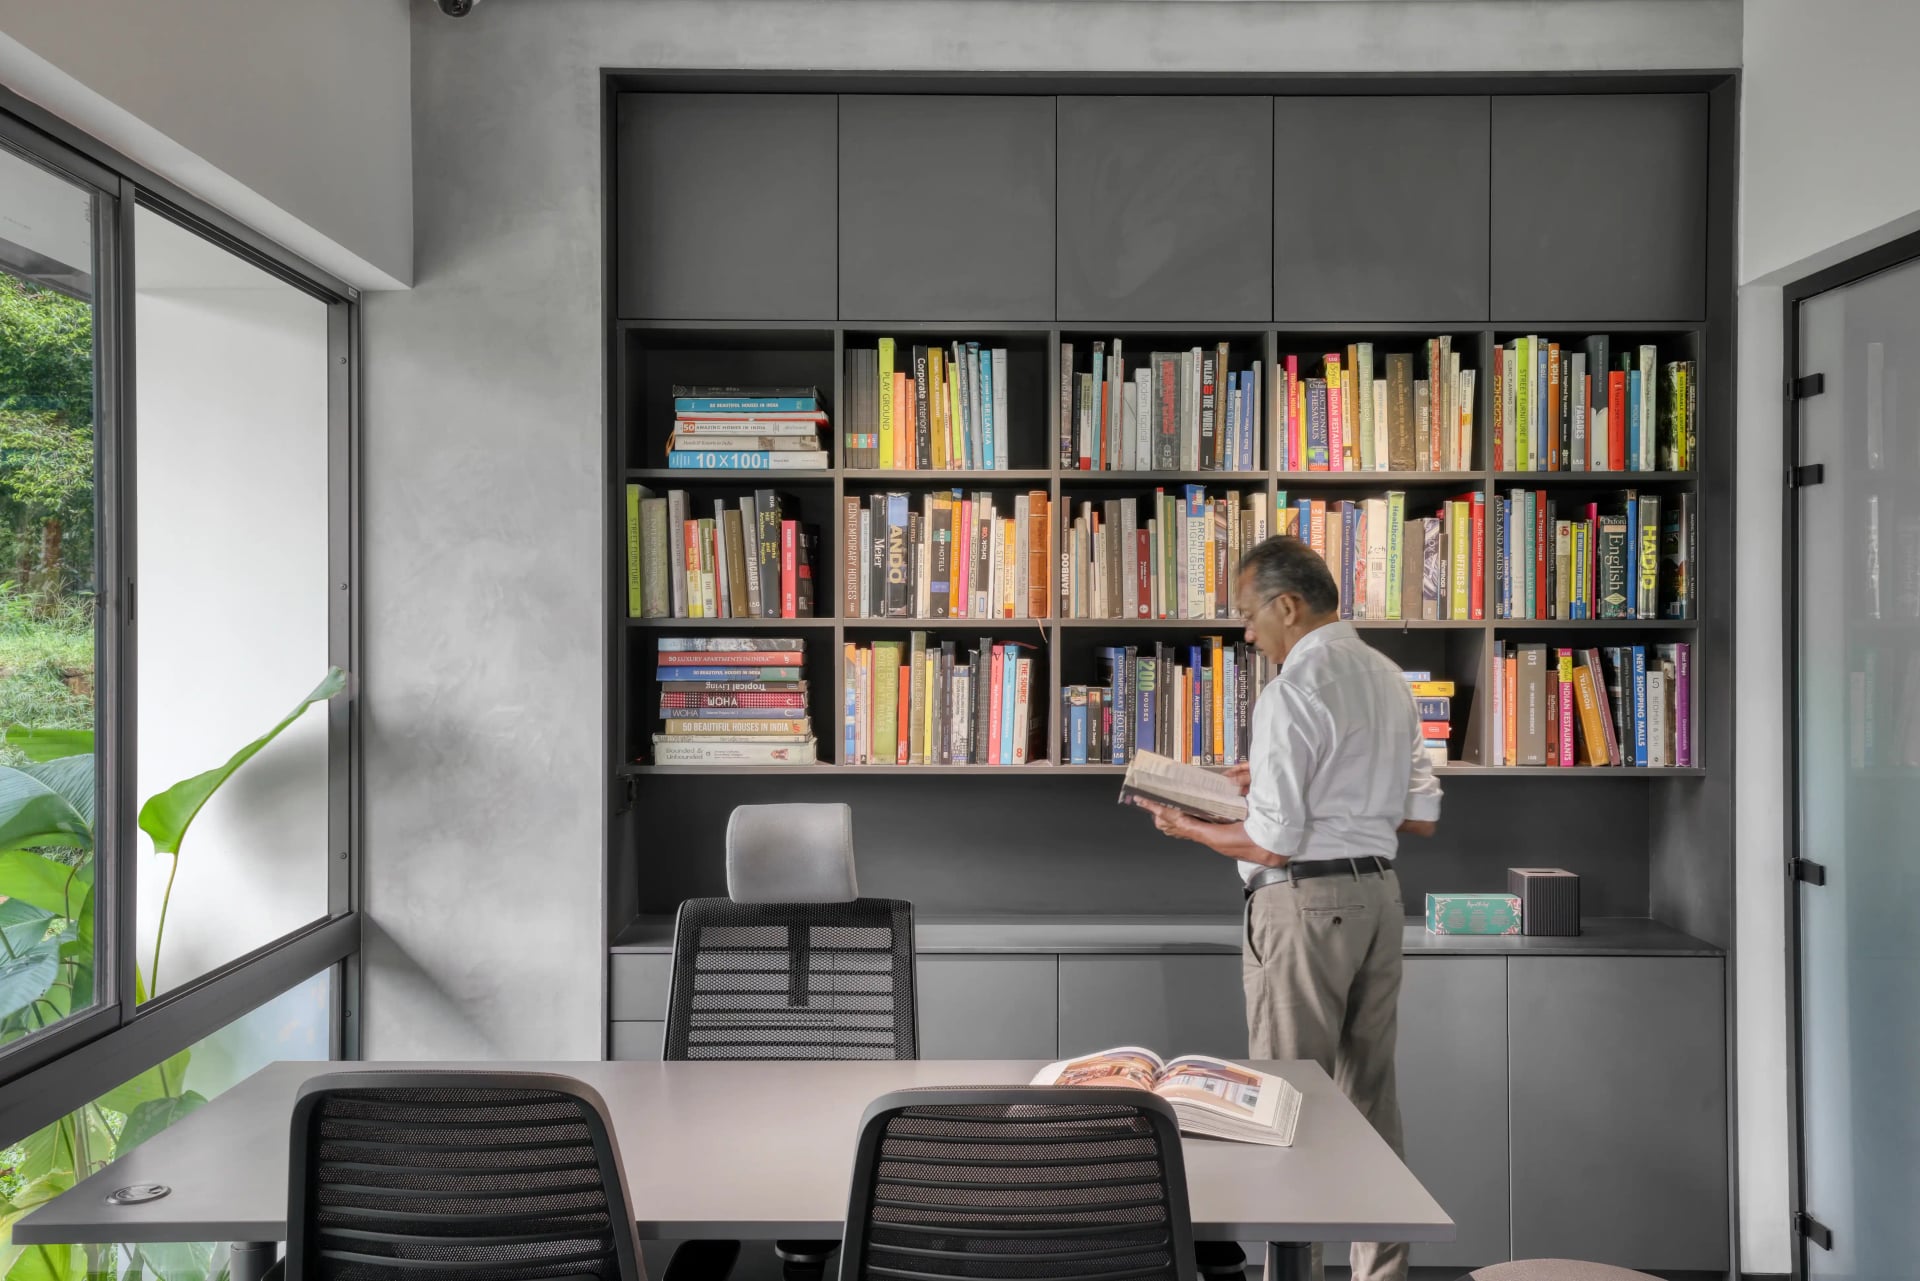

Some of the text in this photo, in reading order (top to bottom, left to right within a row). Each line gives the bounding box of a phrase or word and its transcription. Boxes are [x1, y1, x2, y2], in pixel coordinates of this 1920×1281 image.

[1203, 359, 1213, 385] VILLAS
[1550, 363, 1559, 385] brick
[882, 371, 890, 431] PLAY GROUND
[917, 357, 928, 434] Corporate Interiors
[1203, 395, 1213, 408] THE
[1311, 390, 1319, 440] THESAURUS
[683, 423, 695, 431] 50
[1203, 411, 1213, 437] WORLD
[1319, 390, 1328, 444] DICTIONARY
[1576, 405, 1585, 439] FACADES
[1331, 417, 1340, 467] RESTAURANTS
[1312, 516, 1322, 546] INDIAN
[1496, 500, 1504, 580] ARTS AND ARTISTS
[1601, 517, 1626, 526] Oxford
[848, 503, 857, 600] CONTEMPORARY HOUSES
[874, 538, 885, 568] Meier
[889, 525, 903, 584] ANDO
[1197, 521, 1205, 595] ARCHITECTURE
[1389, 505, 1399, 582] Healthcare Spaces
[1604, 534, 1623, 591] English
[1641, 525, 1657, 590] HADID
[749, 557, 759, 591] FACADES
[1061, 553, 1069, 596] BAMBOO
[1457, 554, 1465, 593] OFFICES-2
[1138, 661, 1155, 692] 200
[1528, 650, 1537, 666] 101
[705, 682, 767, 691] Tropical Living
[915, 669, 923, 690] Hotel
[1020, 662, 1029, 704] THE SOURCE
[1239, 670, 1247, 728] Lighting Spaces
[1579, 673, 1591, 710] HOSPITAL
[1637, 675, 1645, 718] SHOPPING
[707, 697, 738, 706] WOHA
[682, 722, 789, 732] 50 BEAUTIFUL HOUSES IN INDIA
[1116, 710, 1125, 749] HOUSES
[1563, 711, 1571, 761] RESTAURANTS
[1637, 720, 1645, 747] MALLS
